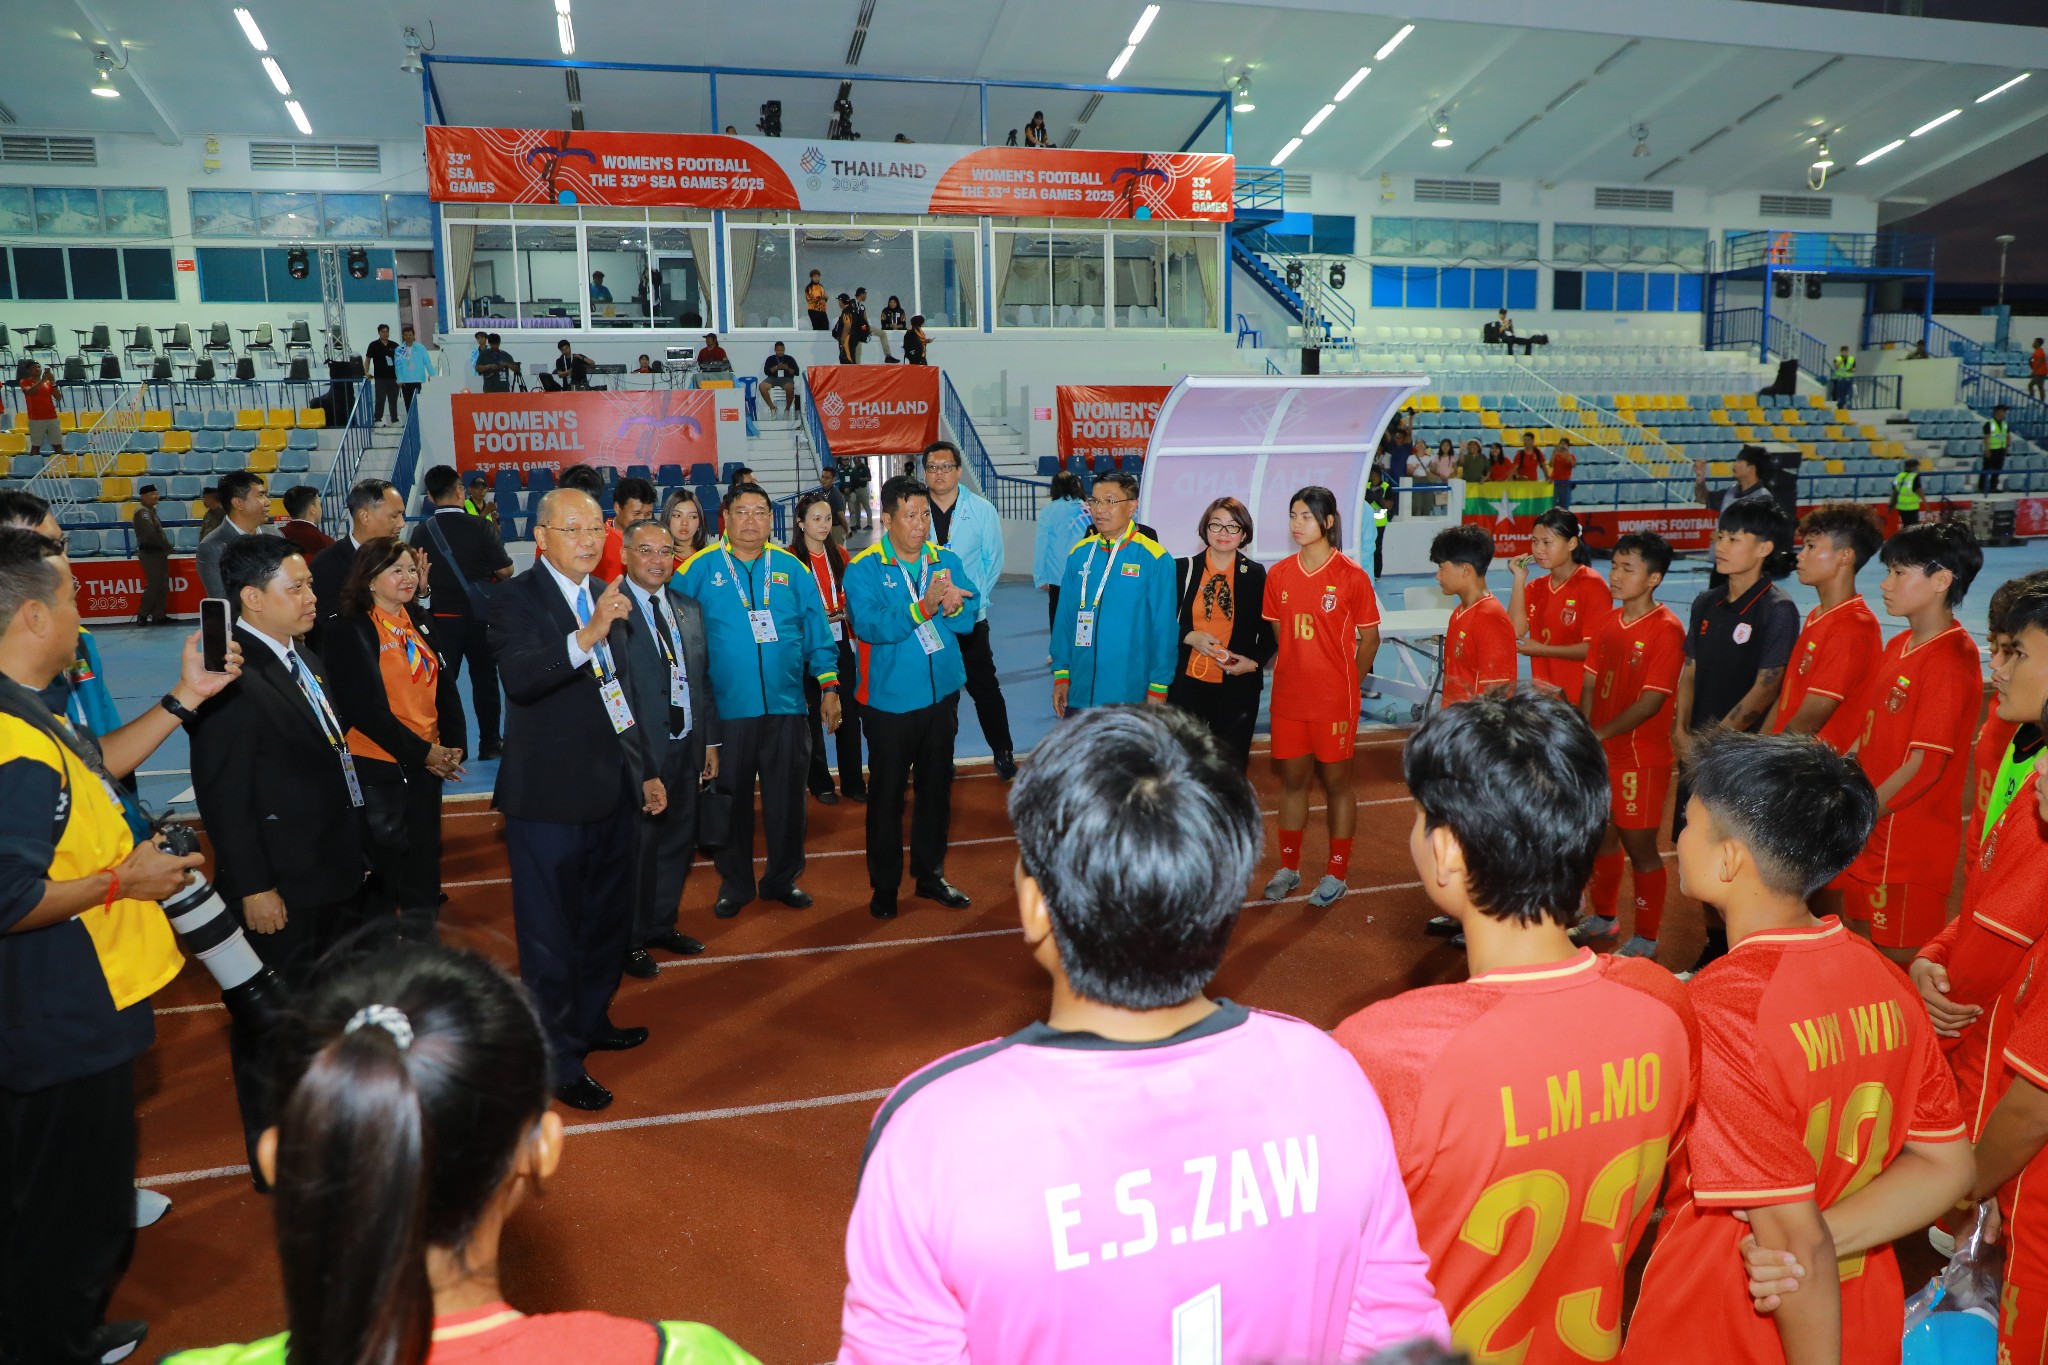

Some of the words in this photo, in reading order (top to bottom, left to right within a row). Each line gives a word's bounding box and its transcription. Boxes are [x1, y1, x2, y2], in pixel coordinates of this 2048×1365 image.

[448, 153, 471, 165] 33rd
[601, 154, 674, 170] WOMEN'S
[677, 157, 752, 173] FOOTBALL
[448, 167, 474, 179] SEA
[831, 160, 927, 179] THAILAND
[971, 167, 1035, 183] WOMEN'S
[1038, 170, 1104, 186] FOOTBALL
[449, 181, 496, 194] GAMES
[589, 173, 617, 187] THE
[620, 174, 647, 188] 33rd
[649, 175, 677, 189] SEA
[680, 175, 728, 190] GAMES
[731, 177, 765, 191] 2025
[831, 177, 870, 192] 2025
[1191, 176, 1211, 188] 33rd
[960, 185, 984, 198] THE
[987, 186, 1011, 199] 33rd
[1013, 186, 1037, 200] SEA
[1039, 187, 1082, 201] GAMES
[1085, 189, 1115, 202] 2025
[1191, 189, 1213, 200] SEA
[1191, 201, 1228, 213] GAMES
[847, 400, 929, 416] THAILAND
[1072, 401, 1160, 420] WOMEN'S
[471, 409, 578, 432] WOMEN'S
[849, 417, 881, 429] 2025
[1072, 420, 1151, 439] FOOTBAL
[473, 431, 585, 453] FOOTBALL
[1091, 447, 1110, 457] SEA
[1111, 447, 1144, 457] GAMES
[498, 461, 520, 471] SEA
[522, 460, 561, 471] GAMES
[1617, 520, 1668, 534] WOMEN'S
[85, 577, 189, 596] THAILD
[87, 596, 129, 611] 2025
[1294, 613, 1315, 640] 16
[1622, 771, 1638, 801] 9
[1500, 1052, 1662, 1148] L.M.MO
[1044, 1133, 1320, 1272] E.S.ZAW
[1450, 1132, 1670, 1365] 23
